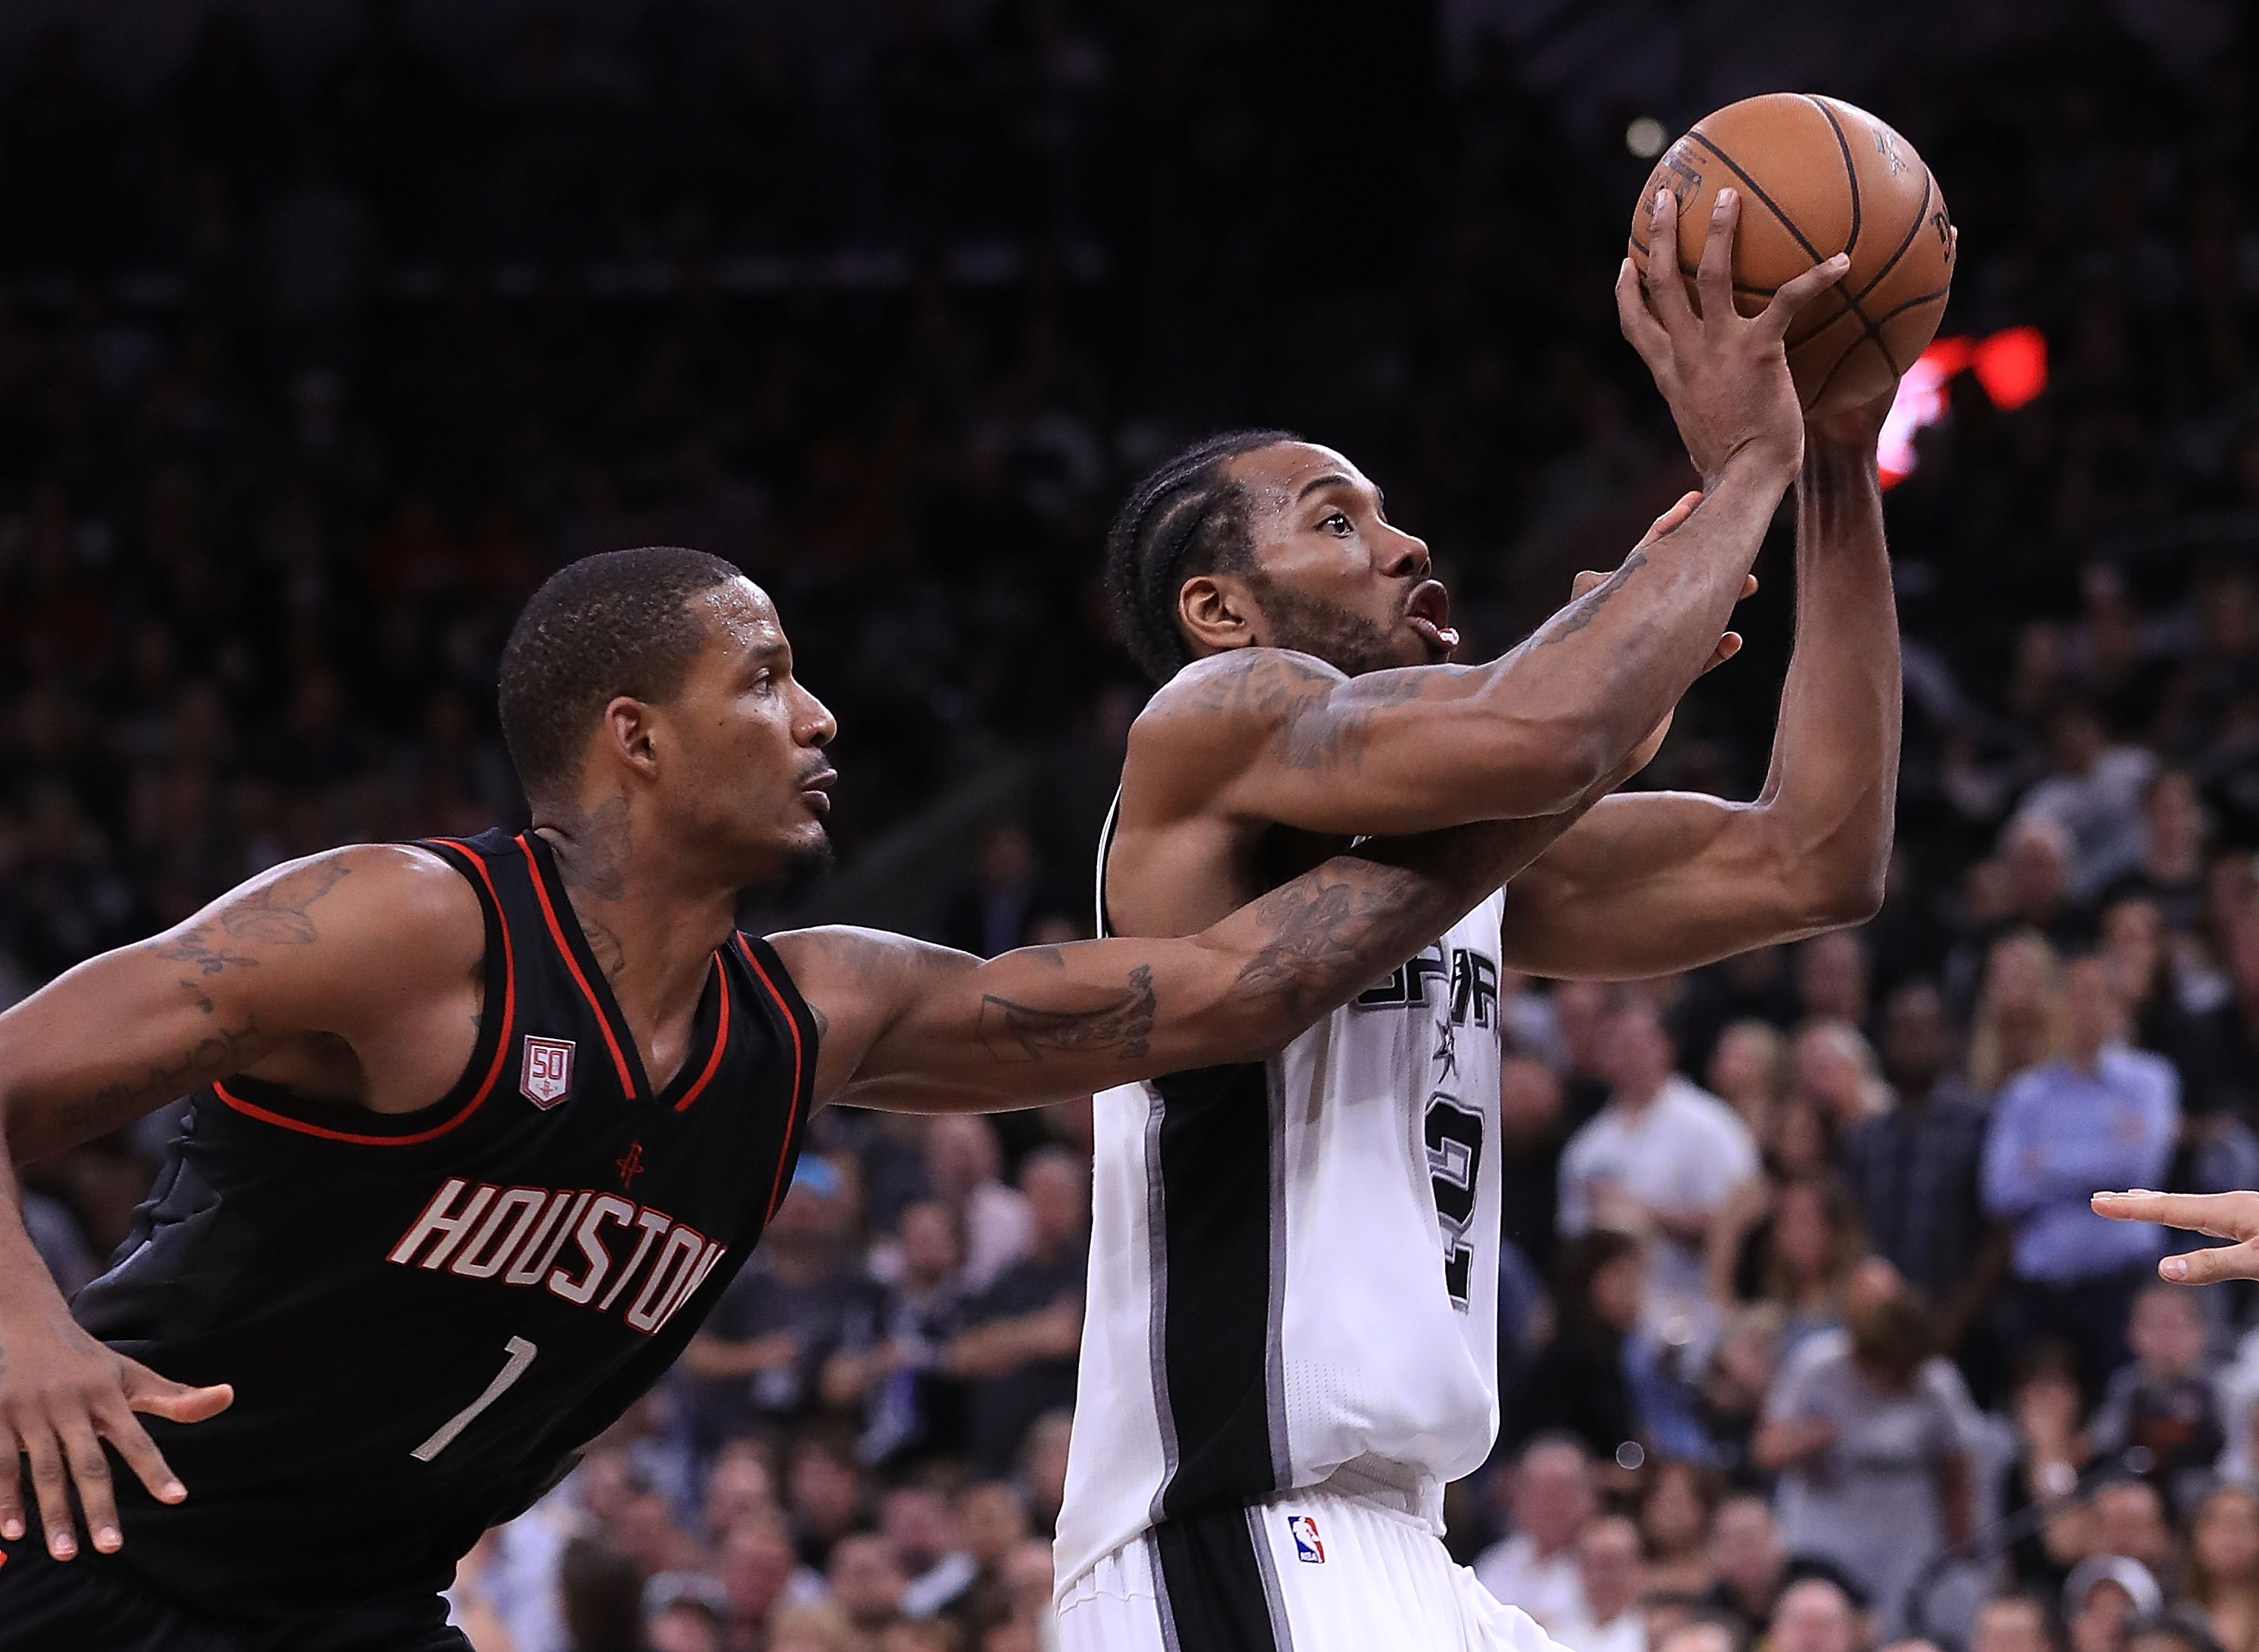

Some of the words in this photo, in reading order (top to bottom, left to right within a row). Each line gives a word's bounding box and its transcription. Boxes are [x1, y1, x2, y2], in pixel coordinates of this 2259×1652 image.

[532, 1047, 563, 1080] 50
[1424, 1091, 1485, 1315] 2
[410, 1335, 538, 1462] 1
